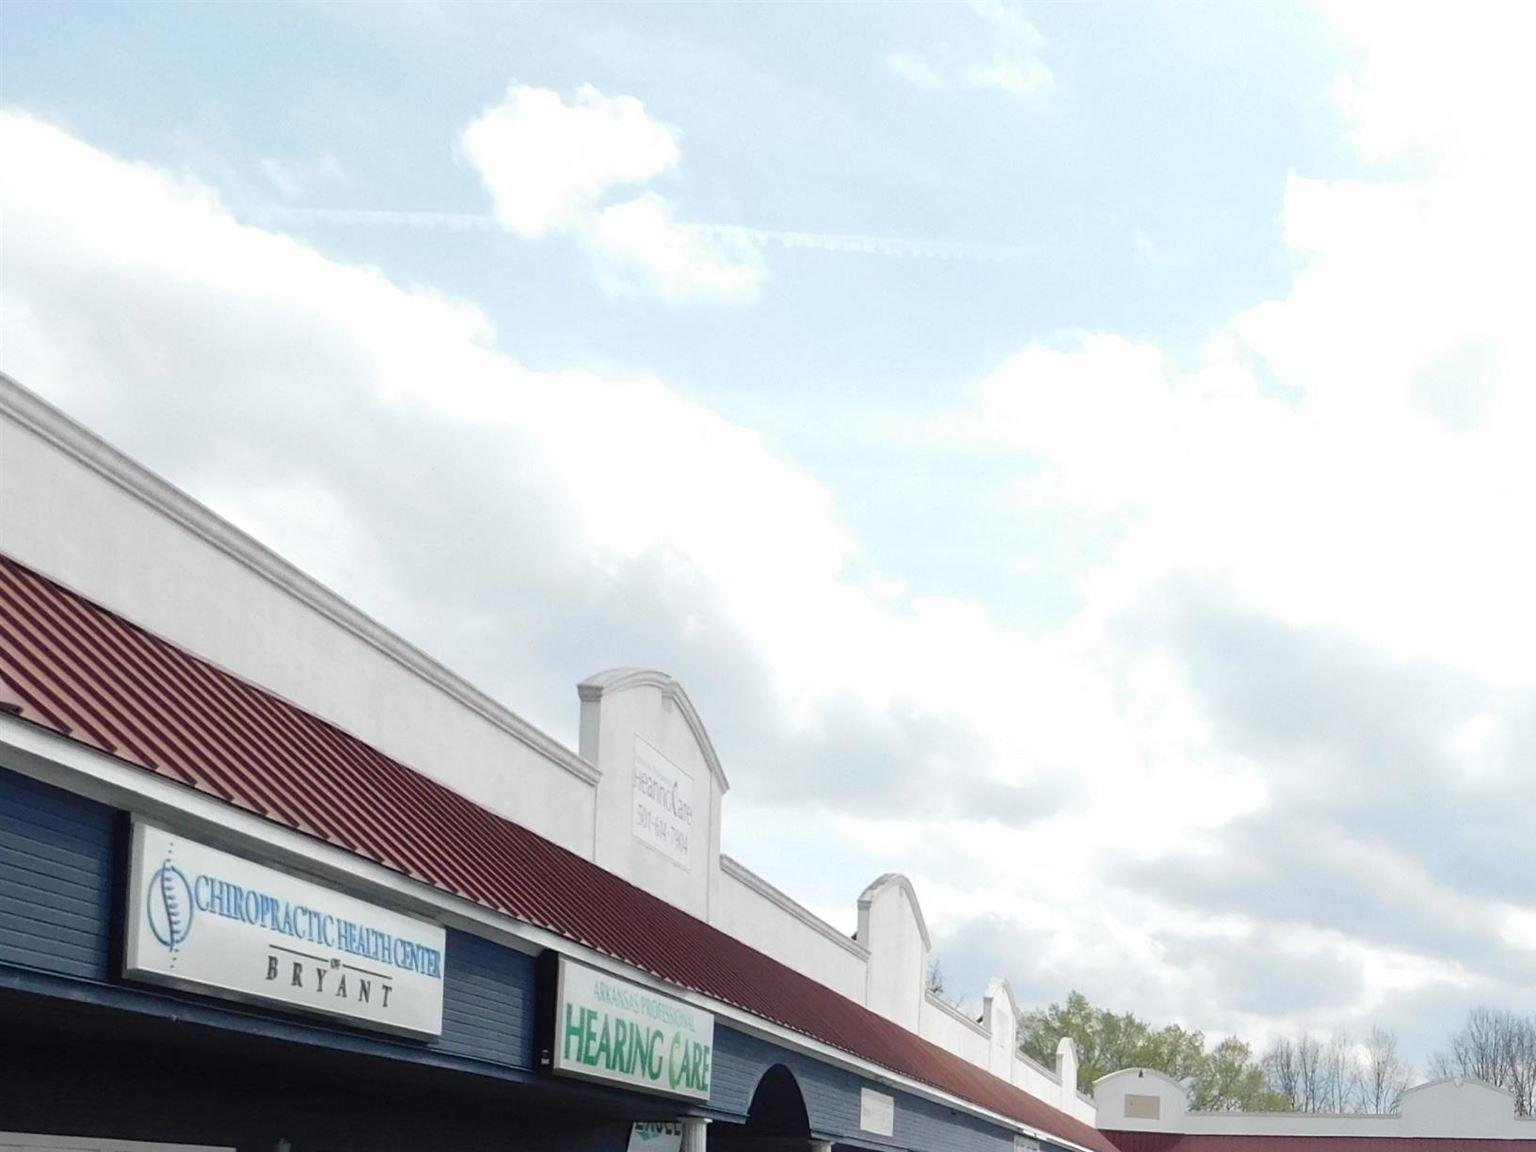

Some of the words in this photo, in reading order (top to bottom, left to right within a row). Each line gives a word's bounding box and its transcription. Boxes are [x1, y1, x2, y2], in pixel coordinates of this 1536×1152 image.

[194, 874, 335, 948] CHIROPRACTIC
[336, 919, 393, 965] HEALTH
[393, 937, 442, 980] CENTER
[265, 955, 393, 1008] BRYANT
[593, 979, 639, 1014] ARKANSAS
[563, 1002, 664, 1081] HEARING
[668, 1030, 711, 1093] CARE
